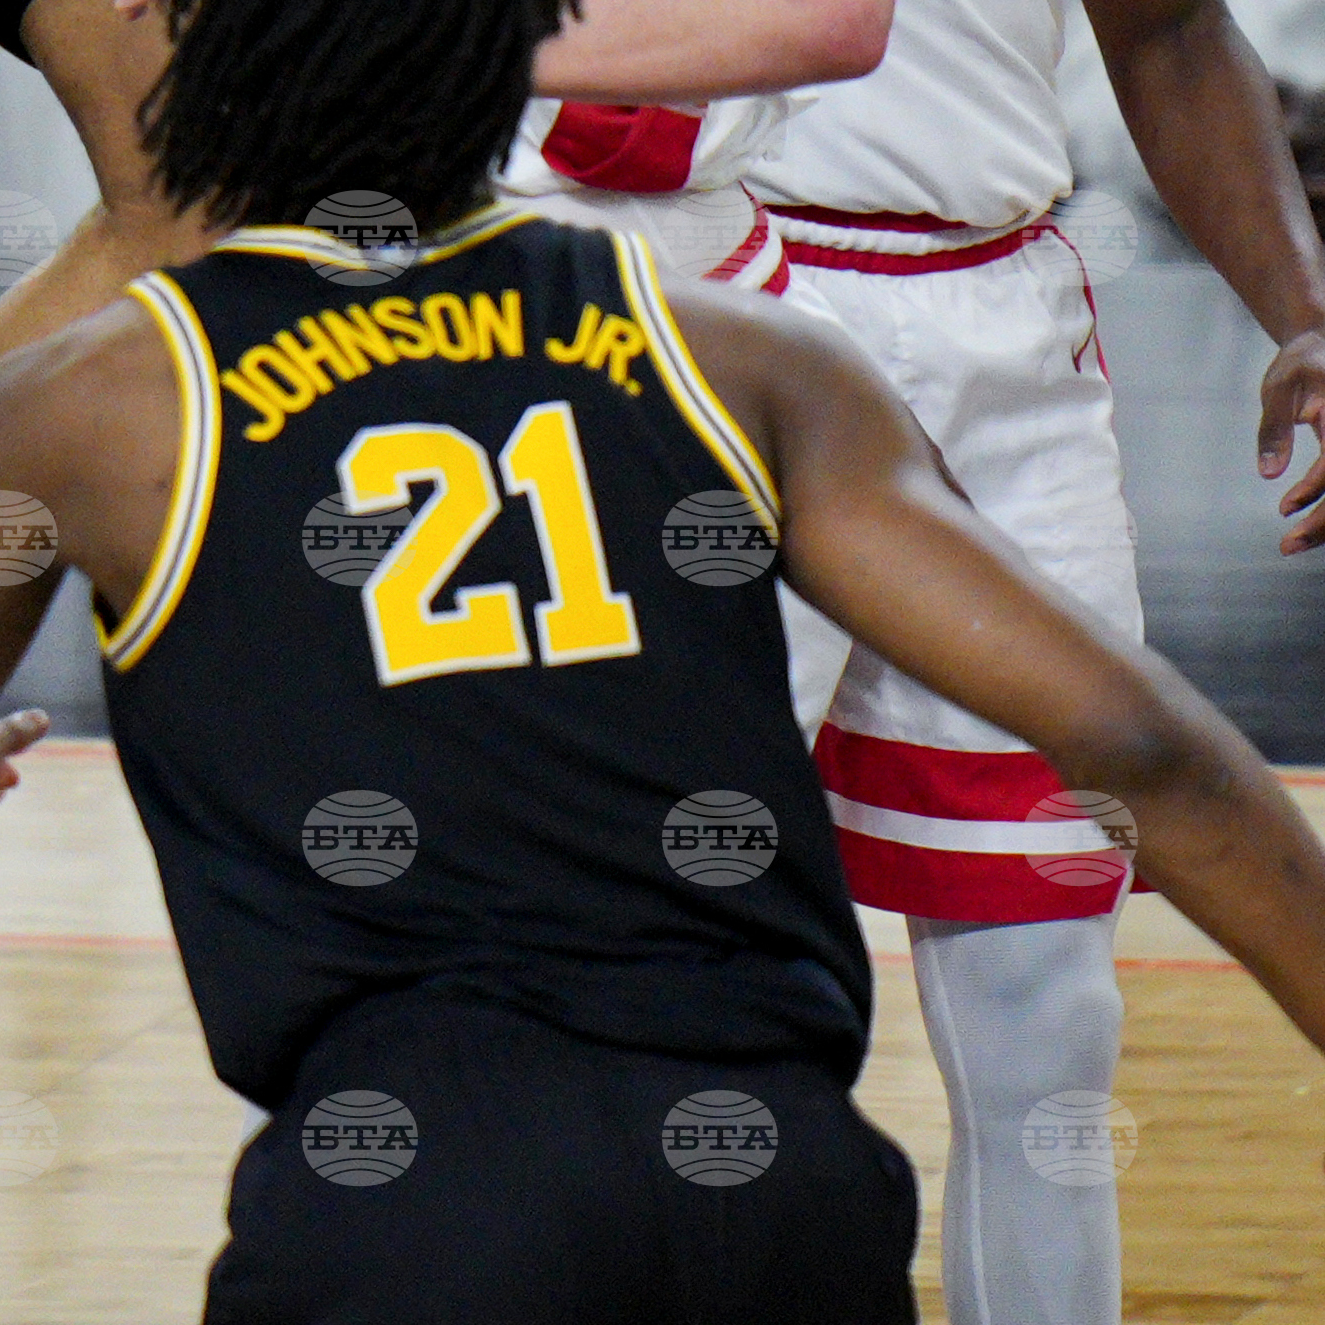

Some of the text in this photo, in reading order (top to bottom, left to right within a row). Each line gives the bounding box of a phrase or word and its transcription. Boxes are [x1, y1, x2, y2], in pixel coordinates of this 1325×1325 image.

[221, 289, 652, 442] JOHNSON JR.
[335, 400, 641, 686] 21
